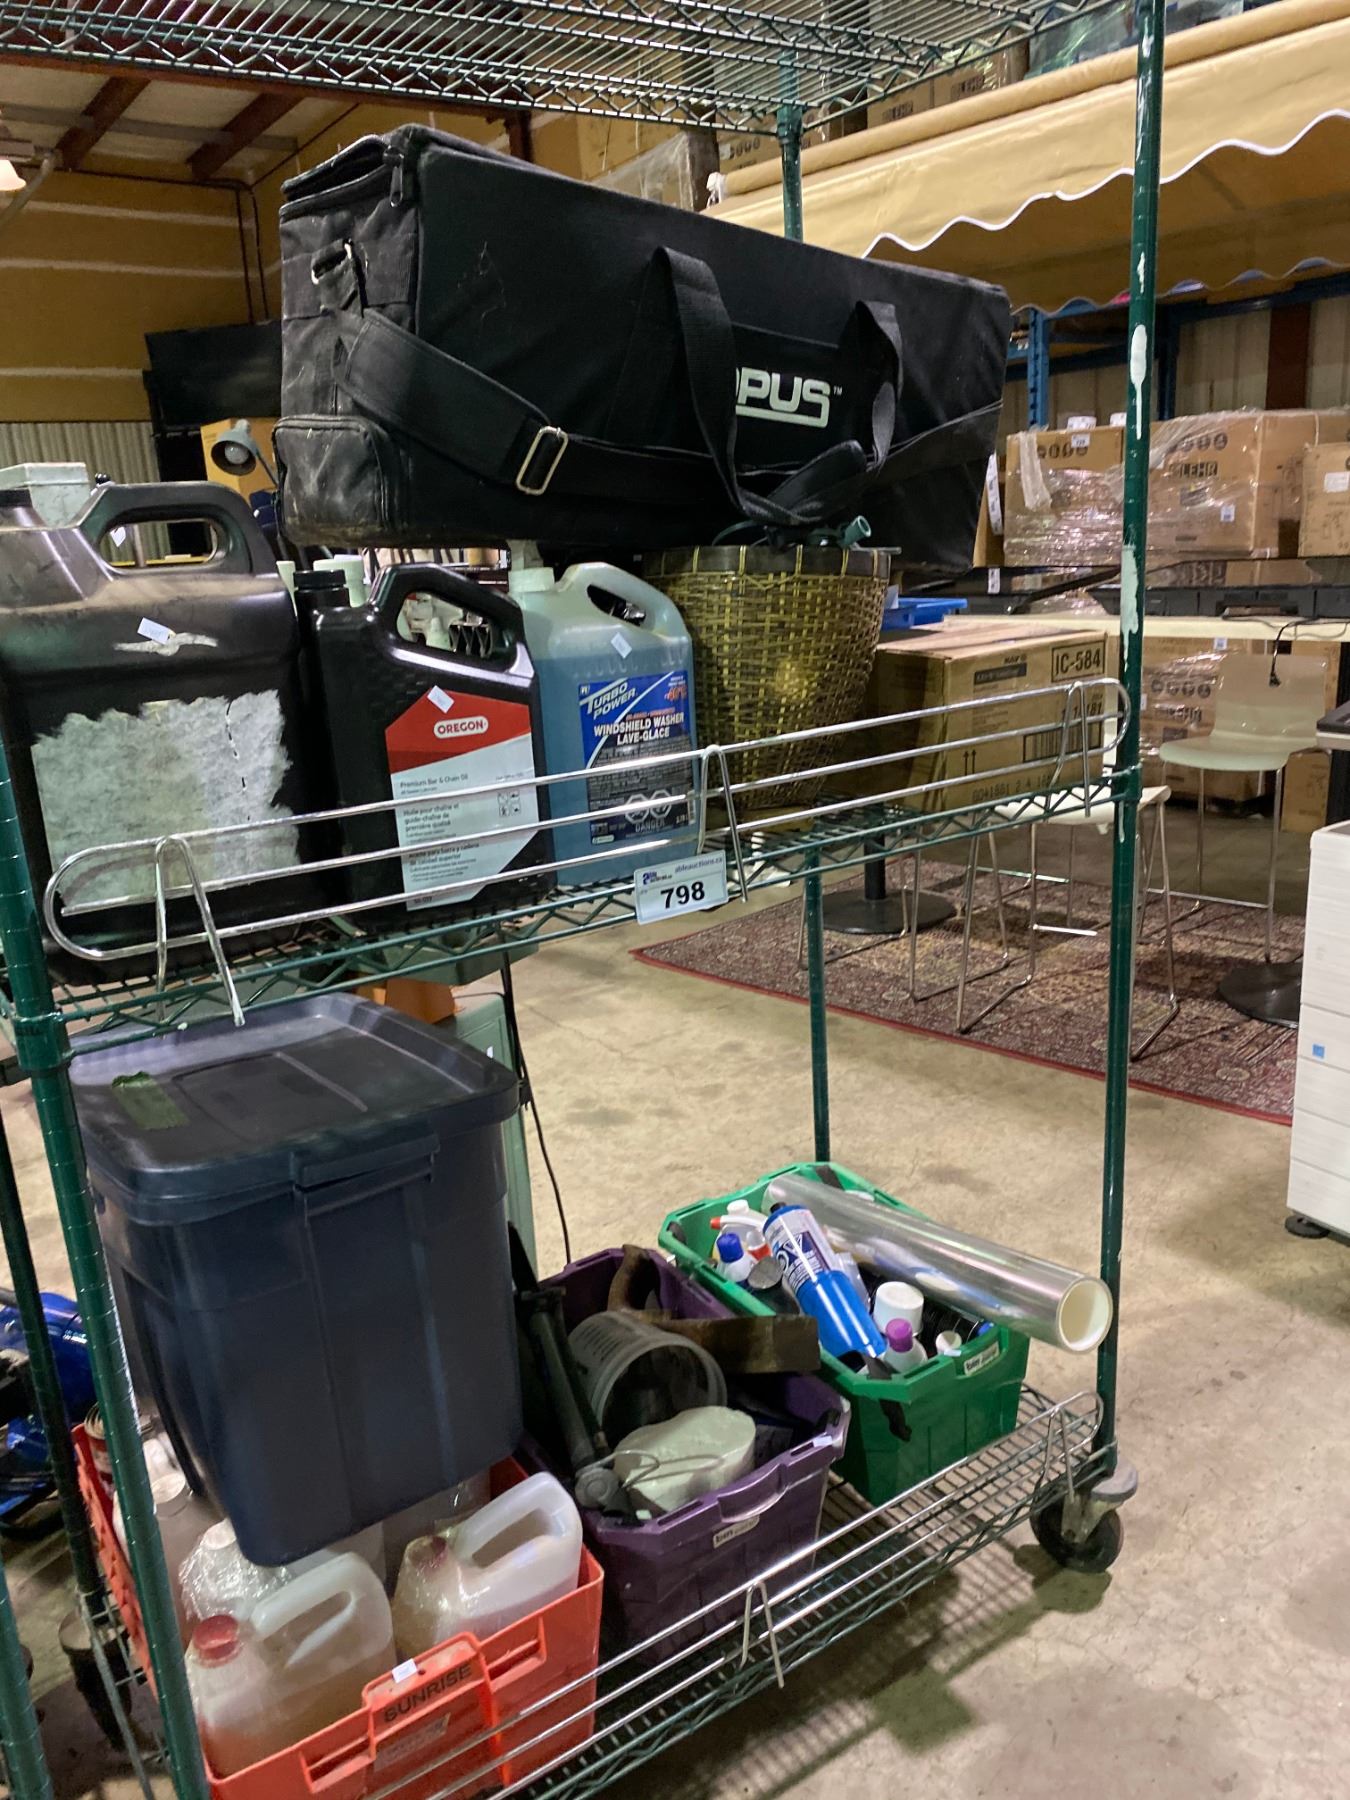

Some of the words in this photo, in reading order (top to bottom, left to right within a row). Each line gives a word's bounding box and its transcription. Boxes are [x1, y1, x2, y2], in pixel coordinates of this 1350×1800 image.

[736, 367, 831, 428] PUS
[1055, 649, 1101, 675] IC-584
[579, 677, 629, 714] TURBO
[593, 688, 636, 720] POWER
[437, 721, 484, 735] OREGON
[593, 717, 651, 737] WINDSHIELD
[653, 712, 684, 728] WASHER
[617, 727, 670, 746] LAVE-GLACE
[400, 779, 427, 789] Premium
[428, 777, 437, 786] Bar
[439, 776, 444, 784] &
[445, 775, 459, 784] Chain
[635, 820, 665, 832] DANGER
[660, 881, 705, 909] 798
[384, 1664, 471, 1723] SUNRISE
